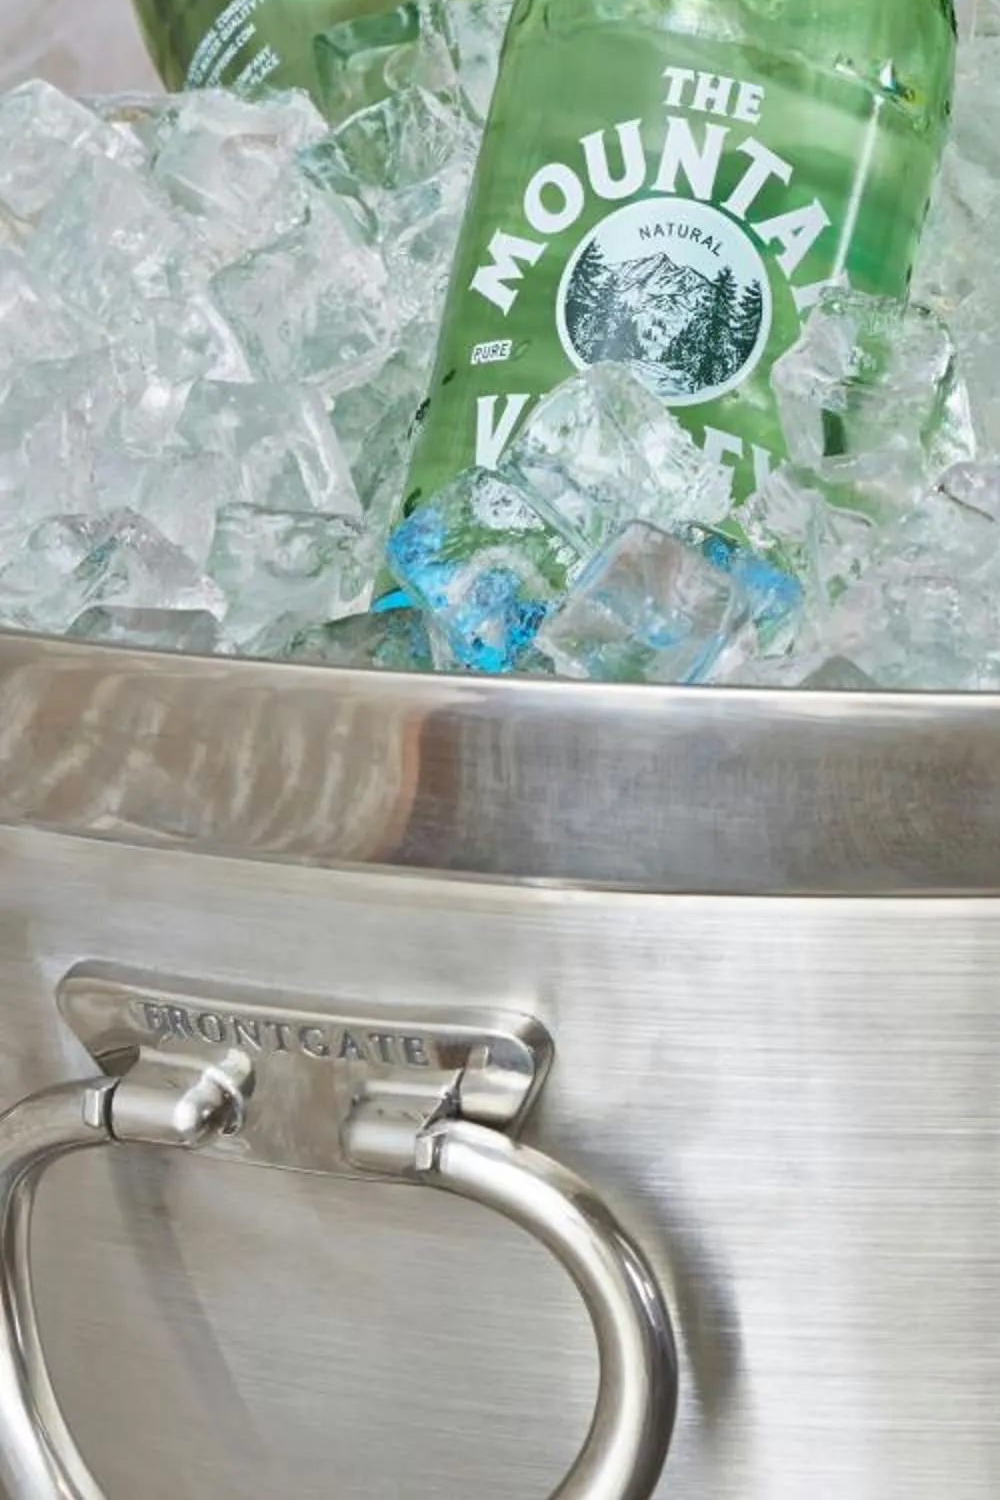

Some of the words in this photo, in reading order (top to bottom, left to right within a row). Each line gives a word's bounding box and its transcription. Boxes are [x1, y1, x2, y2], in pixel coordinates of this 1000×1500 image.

[664, 66, 764, 125] THE
[469, 116, 850, 316] MOUNTAI
[639, 222, 723, 257] NATURAL
[472, 341, 510, 362] PURE
[144, 1003, 430, 1066] FRONTGATE
